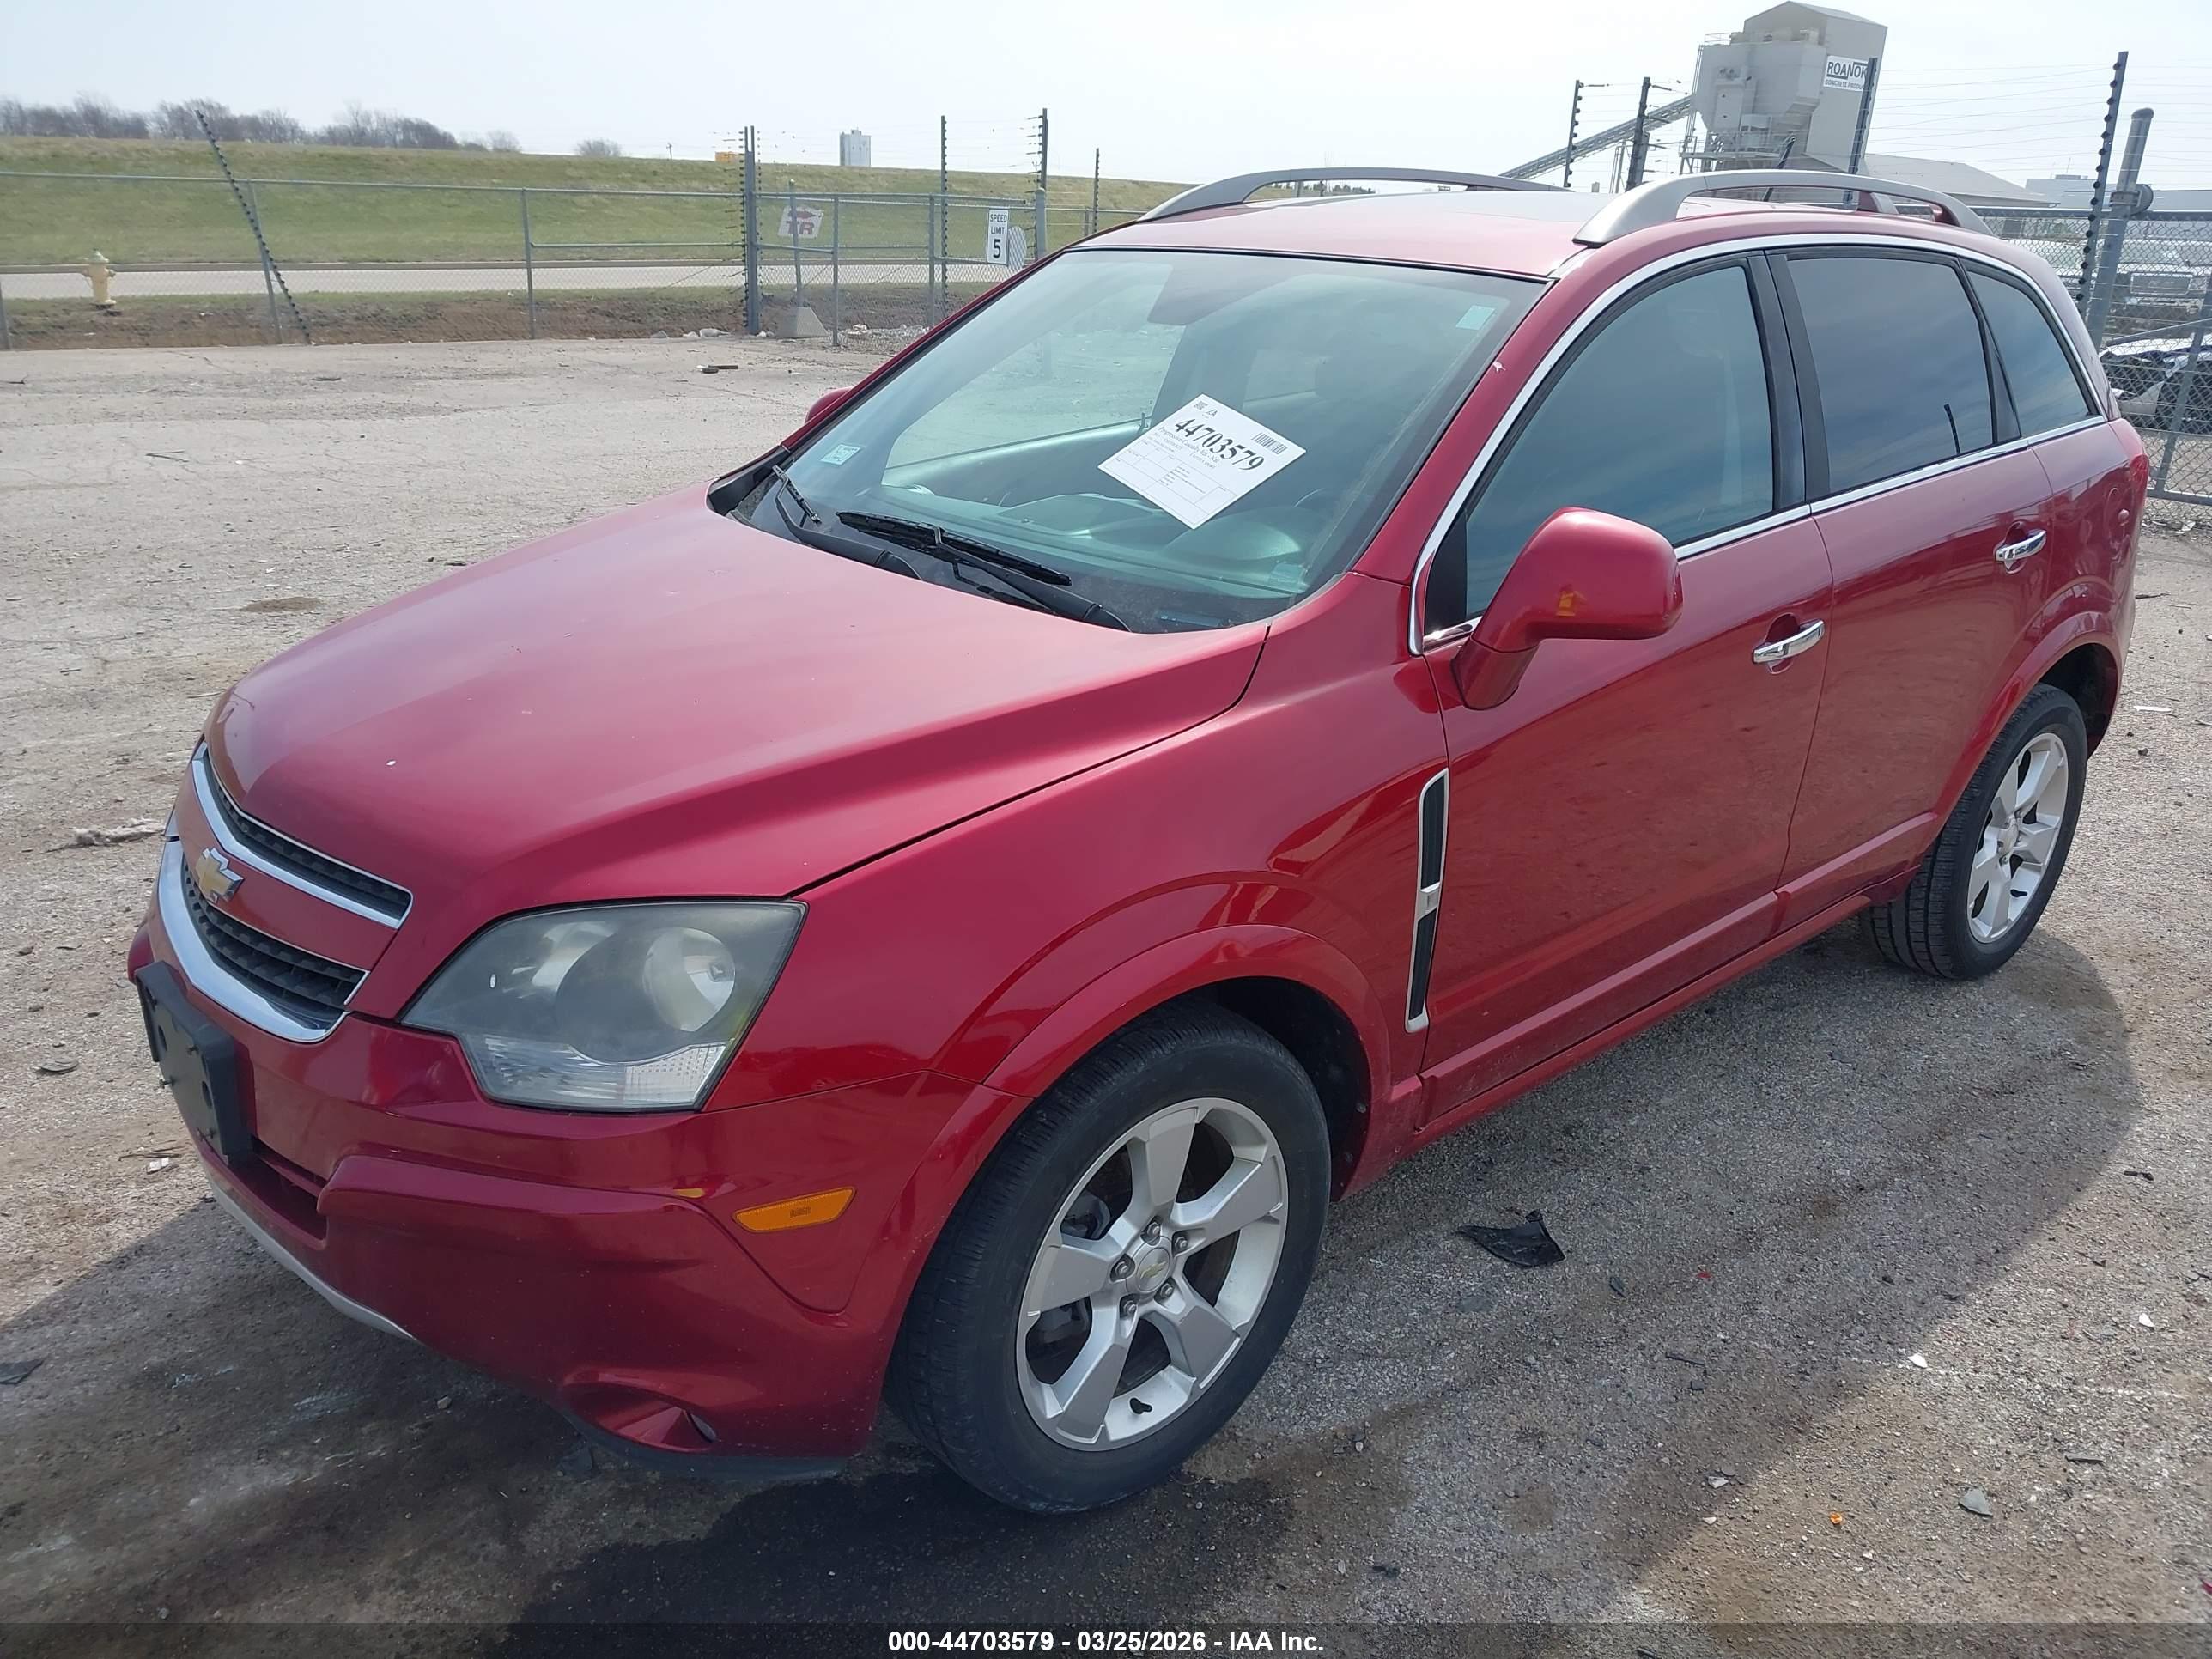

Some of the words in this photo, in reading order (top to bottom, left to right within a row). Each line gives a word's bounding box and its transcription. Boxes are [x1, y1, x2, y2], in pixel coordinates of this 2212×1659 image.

[1826, 61, 1868, 79] ROANOK
[1848, 82, 1864, 90] PRODU
[990, 214, 1007, 222] SPEED
[991, 226, 1006, 234] LIMIT
[993, 238, 1001, 258] 5
[1175, 418, 1265, 471] 44703579
